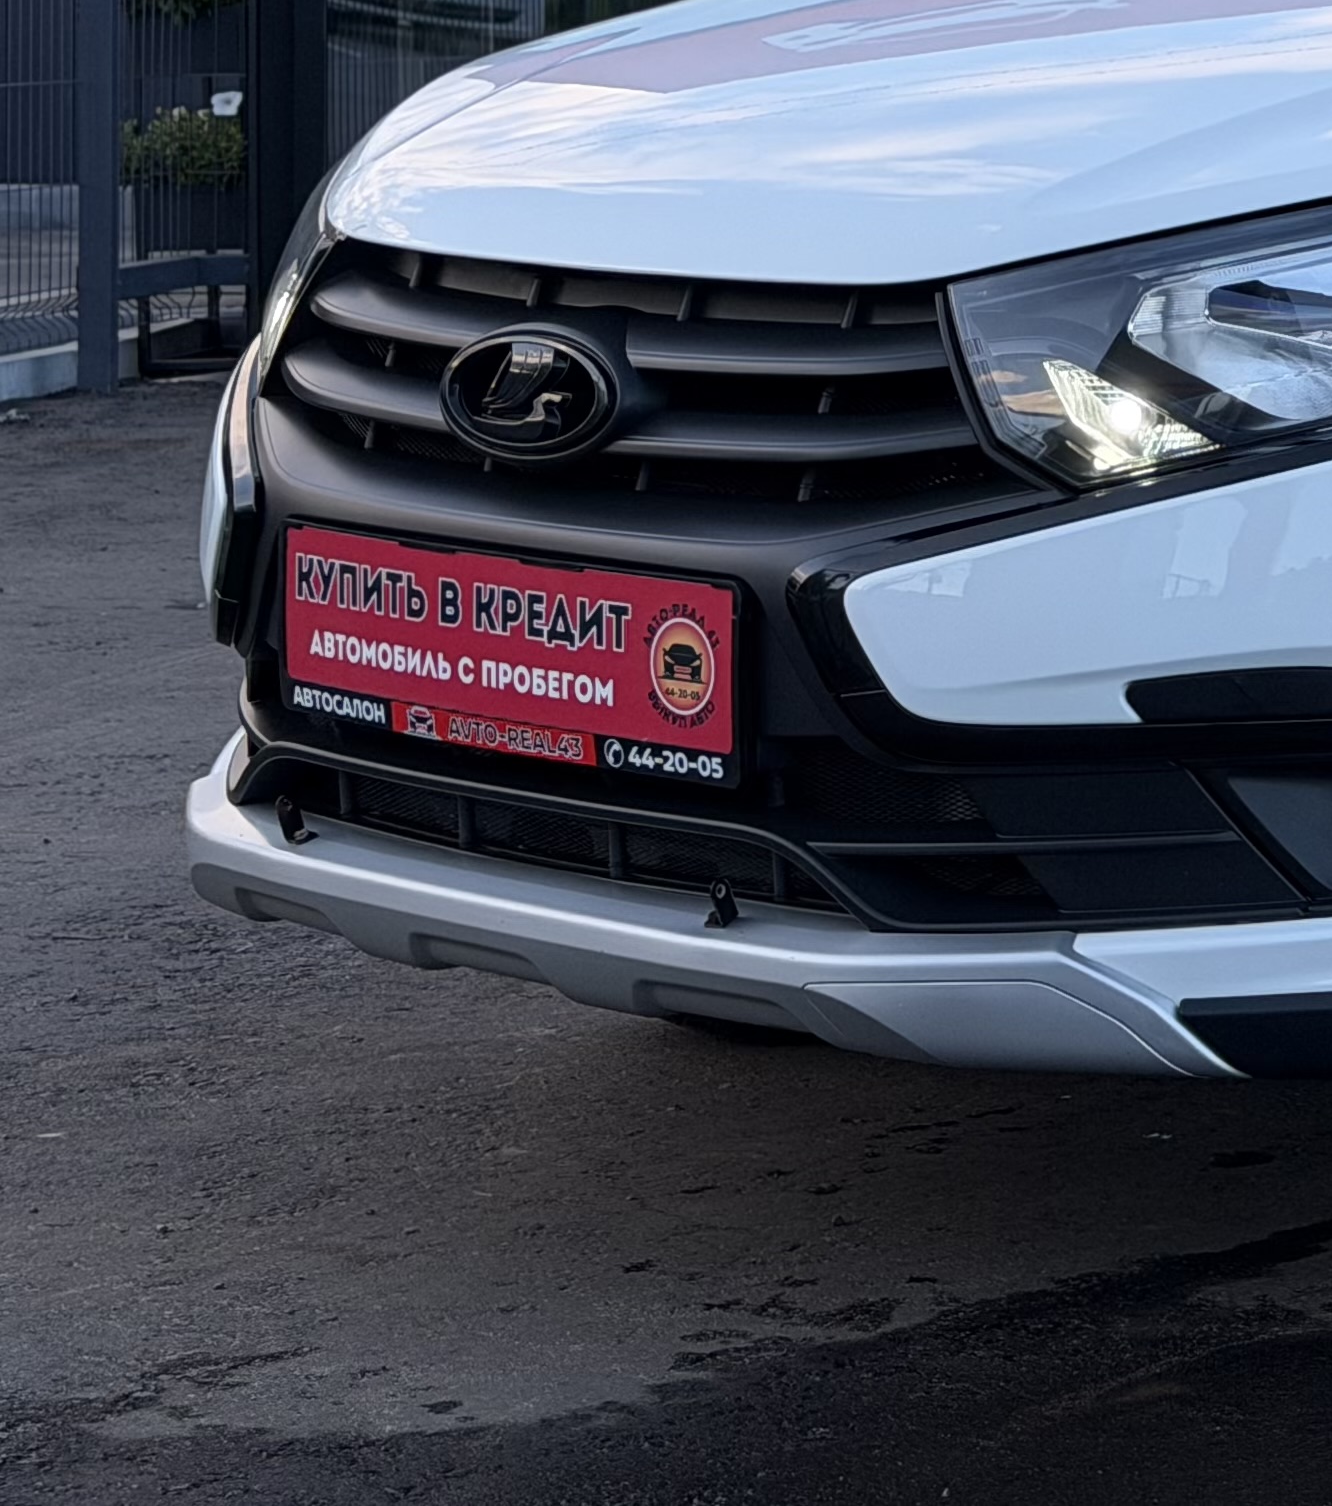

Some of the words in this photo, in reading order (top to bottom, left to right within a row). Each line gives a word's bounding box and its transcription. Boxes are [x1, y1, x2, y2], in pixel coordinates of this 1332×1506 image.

[295, 552, 428, 623] КУПИТЬ
[438, 577, 462, 628] В
[473, 582, 632, 653] КРЕДИТ
[309, 629, 451, 680] АВТОМОБИЛЬ
[457, 655, 475, 685] С
[481, 660, 615, 707] ПРОБЕГОМ
[293, 685, 386, 725] АВТОСАЛОН
[447, 716, 584, 761] AVTO-REAL43
[628, 746, 724, 780] 44-20-05
